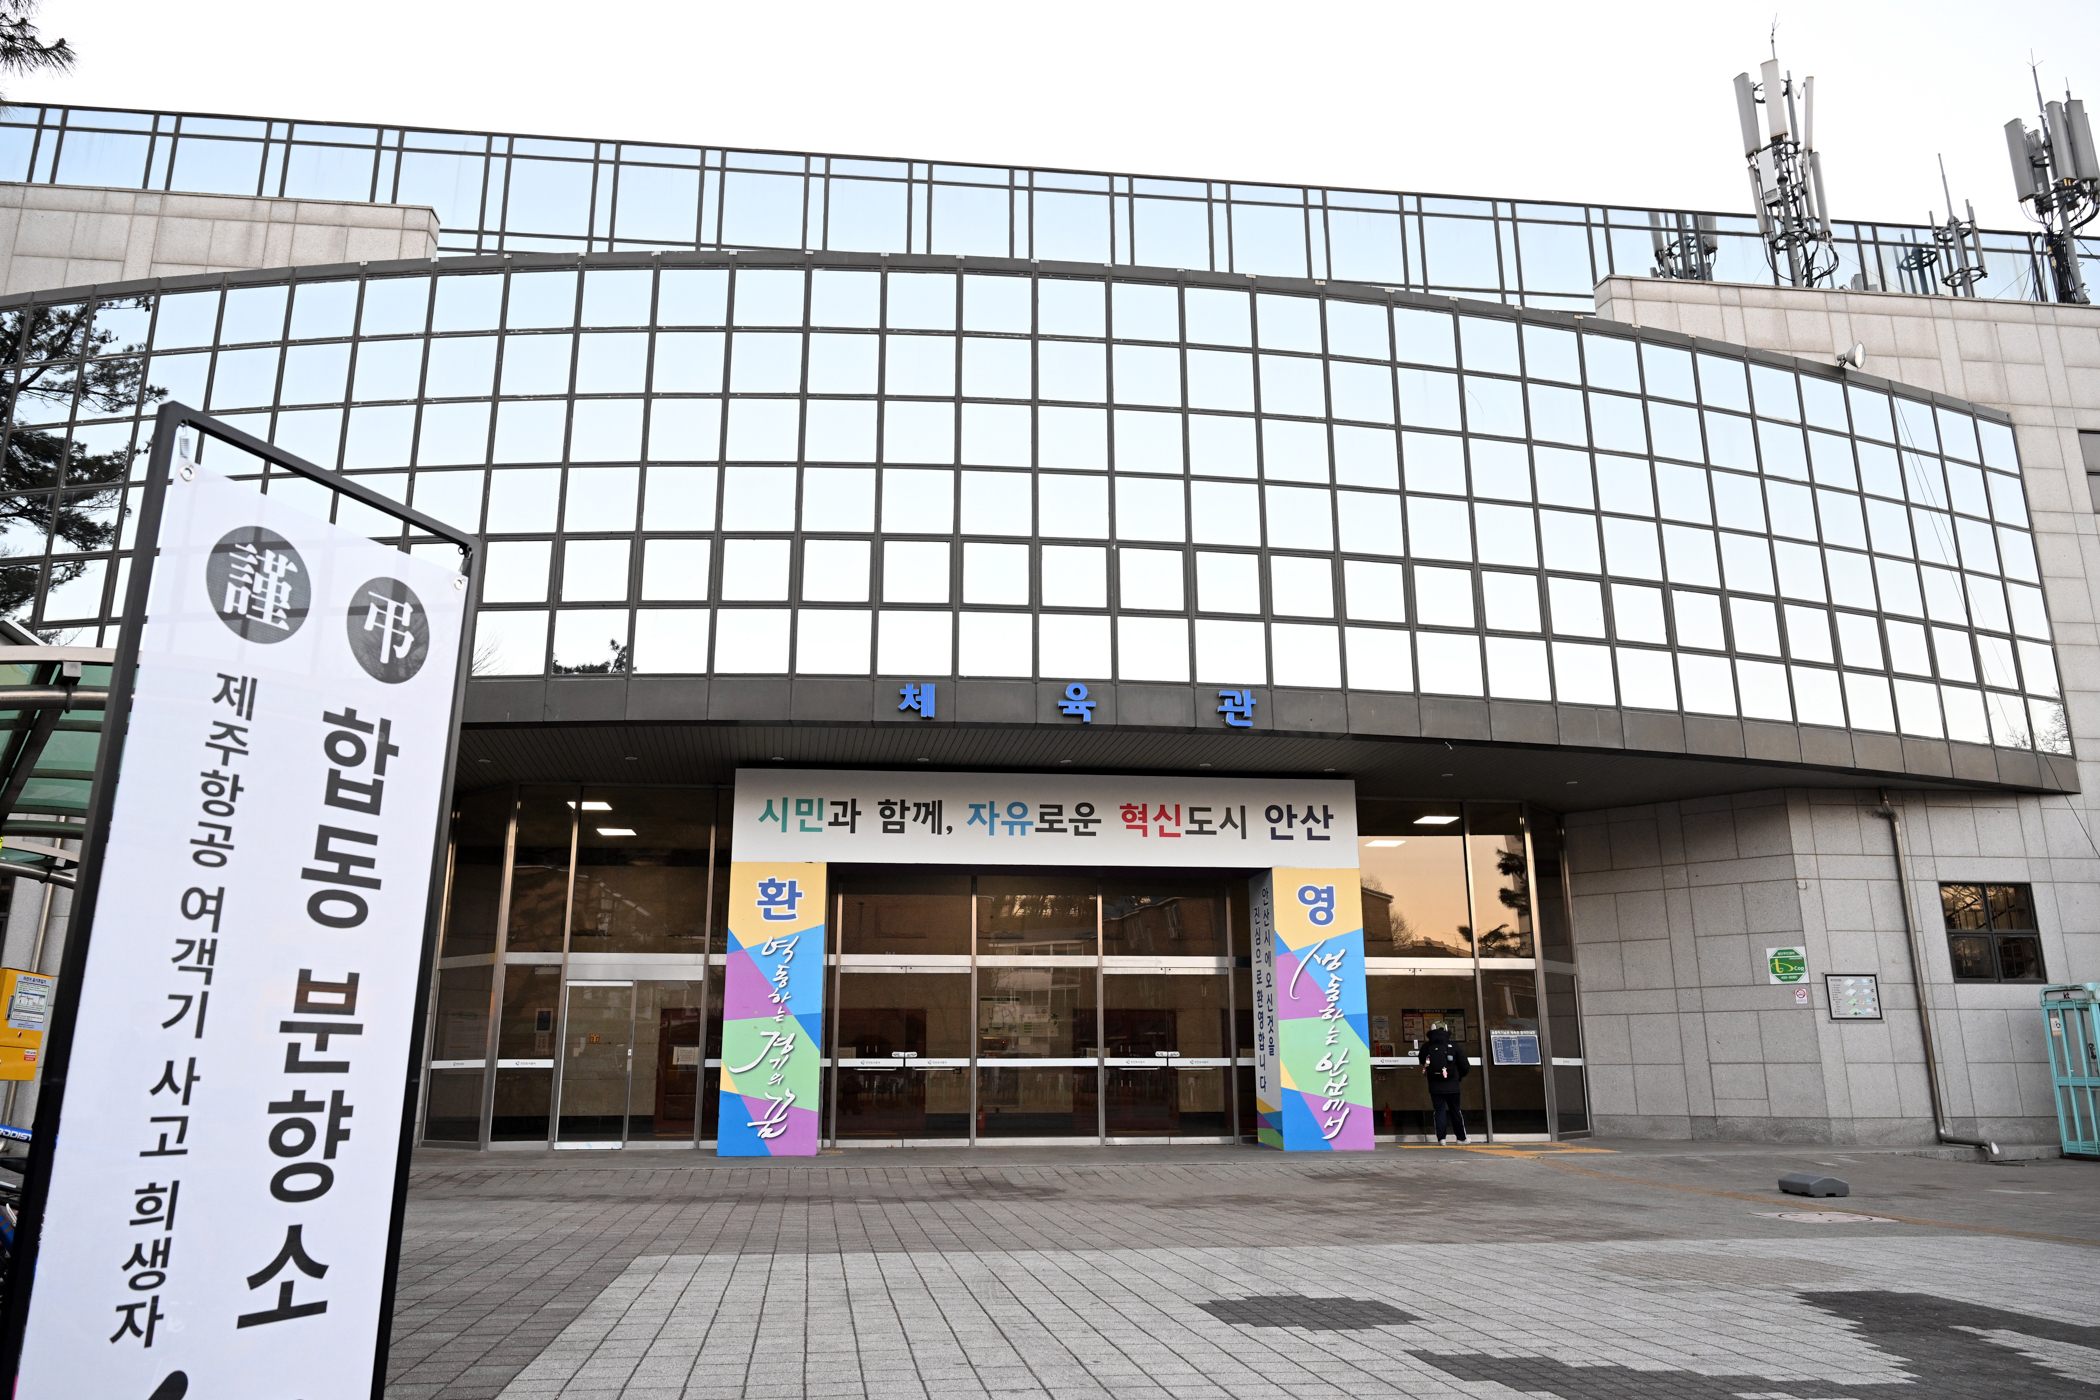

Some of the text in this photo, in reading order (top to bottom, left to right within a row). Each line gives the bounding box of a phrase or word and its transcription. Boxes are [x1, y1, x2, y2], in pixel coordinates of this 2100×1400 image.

[222, 542, 415, 664] 謹 弔
[898, 682, 1257, 728] 체육관
[758, 797, 1335, 842] 시민과 함께, 자유로운 혁신도시 안산
[756, 877, 803, 921] 환
[1261, 886, 1273, 968] 안산시에
[1298, 884, 1337, 926] 영
[109, 672, 258, 1349] 제주항공 여객기 사고 희생자
[236, 706, 400, 1330] 합동 분향소
[1253, 906, 1267, 1093] 진심으로 환영합니다
